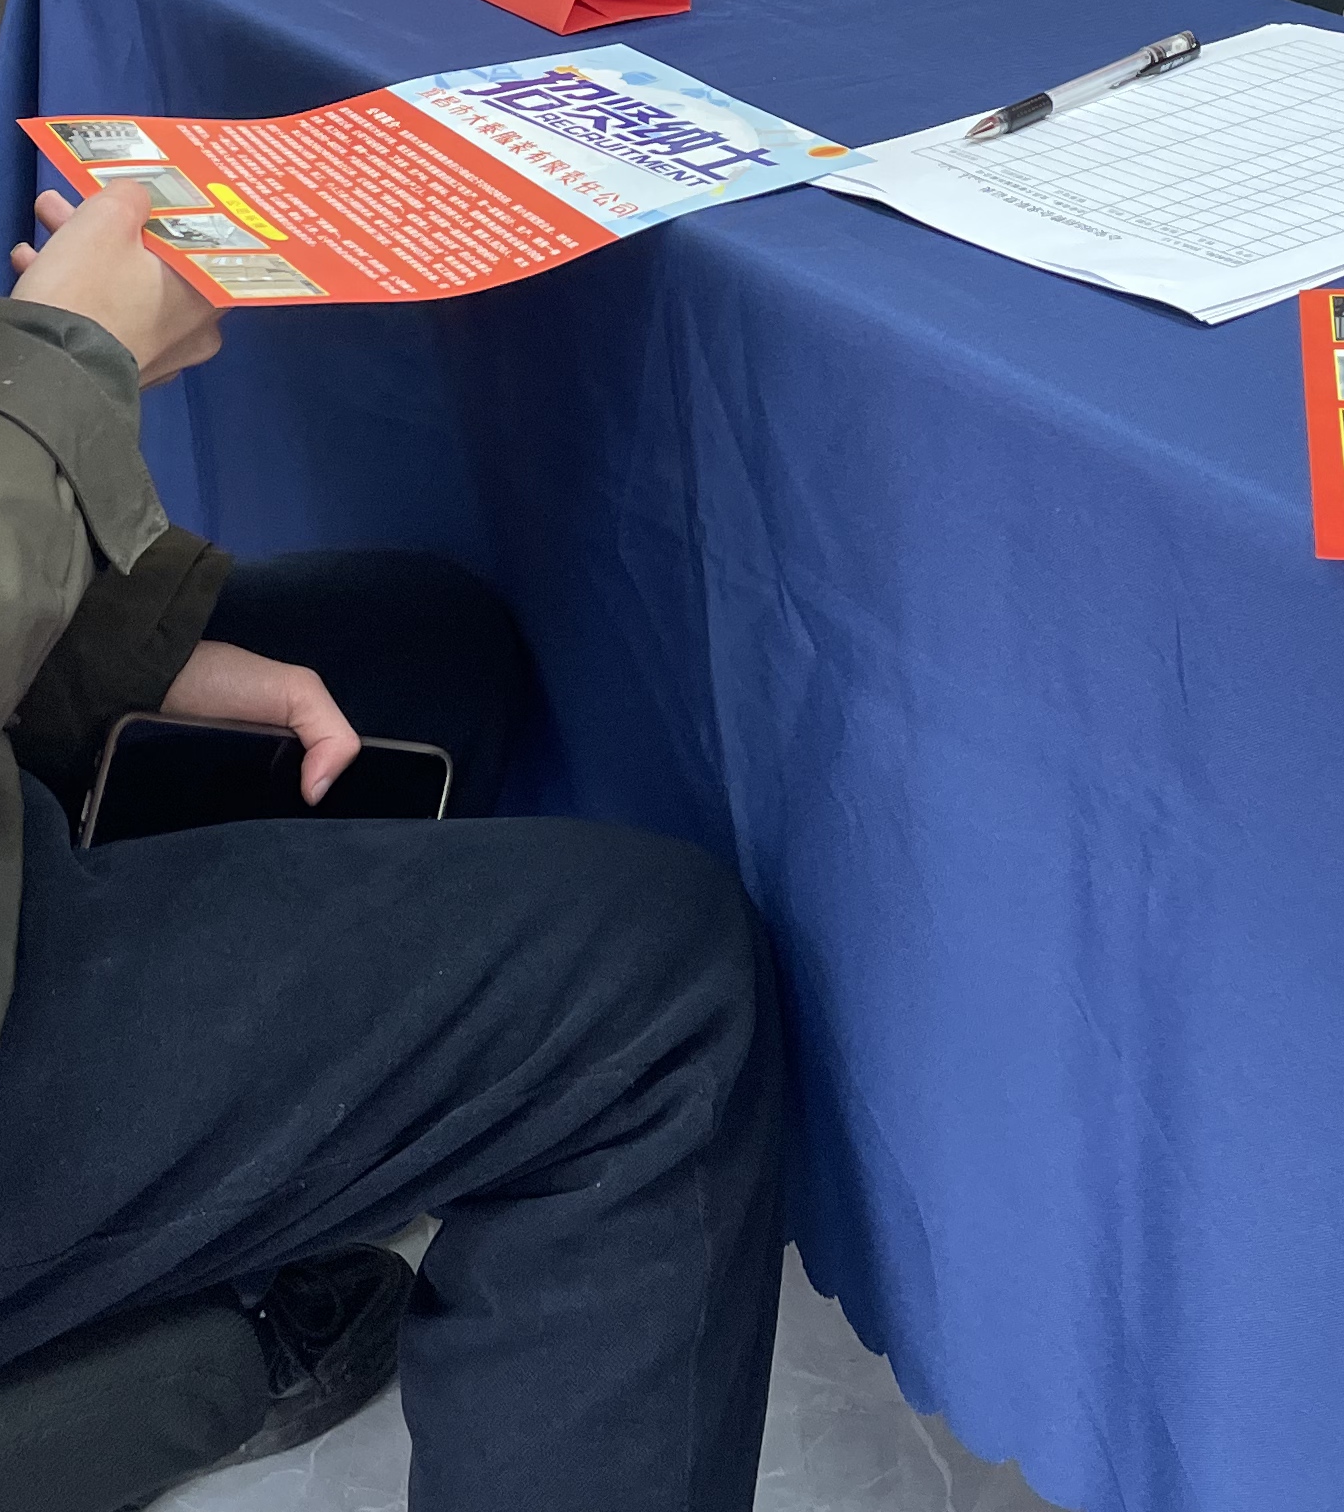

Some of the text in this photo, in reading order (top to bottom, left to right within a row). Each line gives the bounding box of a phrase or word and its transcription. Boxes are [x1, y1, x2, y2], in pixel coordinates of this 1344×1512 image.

[415, 85, 640, 219] 宜昌市大泰服装有限责任公司
[462, 69, 780, 181] 招贤纳士
[532, 112, 715, 189] RECRUITMENT
